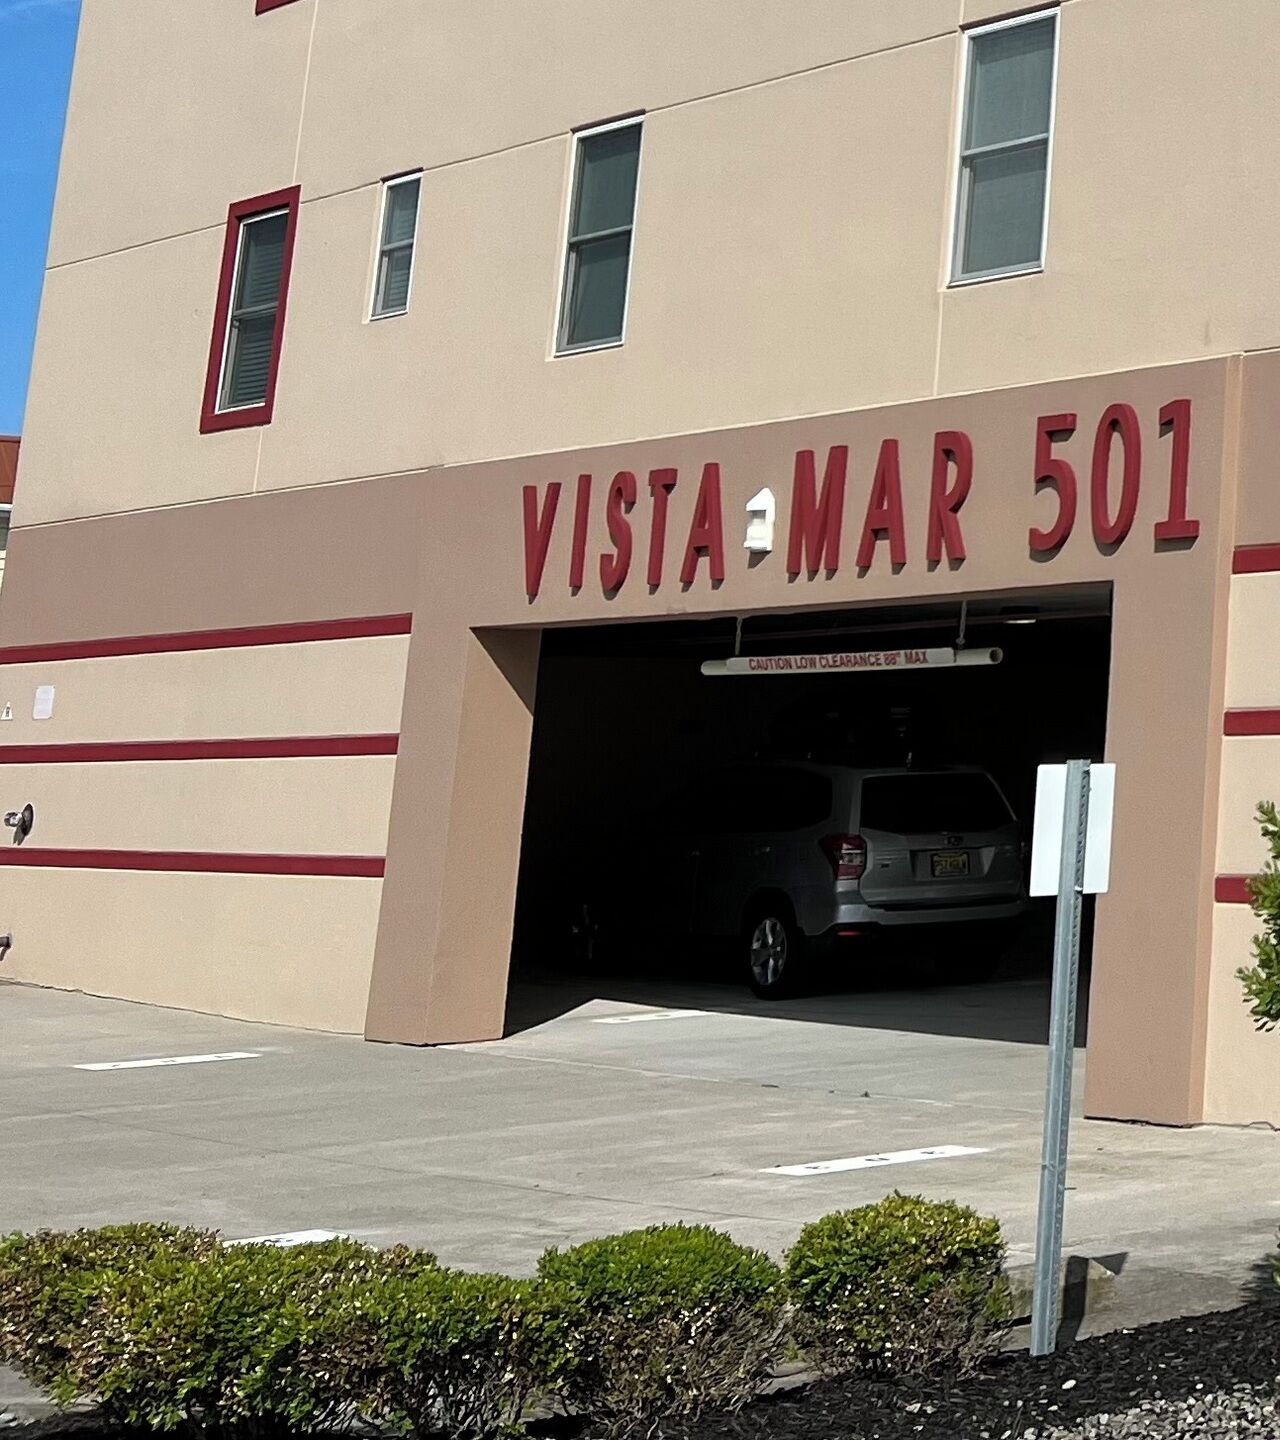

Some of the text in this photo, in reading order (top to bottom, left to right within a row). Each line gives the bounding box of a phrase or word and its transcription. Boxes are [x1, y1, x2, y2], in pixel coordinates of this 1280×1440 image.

[521, 398, 1201, 596] VISTA MAR 501
[749, 657, 793, 671] CAUTION
[796, 655, 817, 670] LOW
[819, 653, 882, 669] CLEARANCE
[904, 650, 929, 666] MAX
